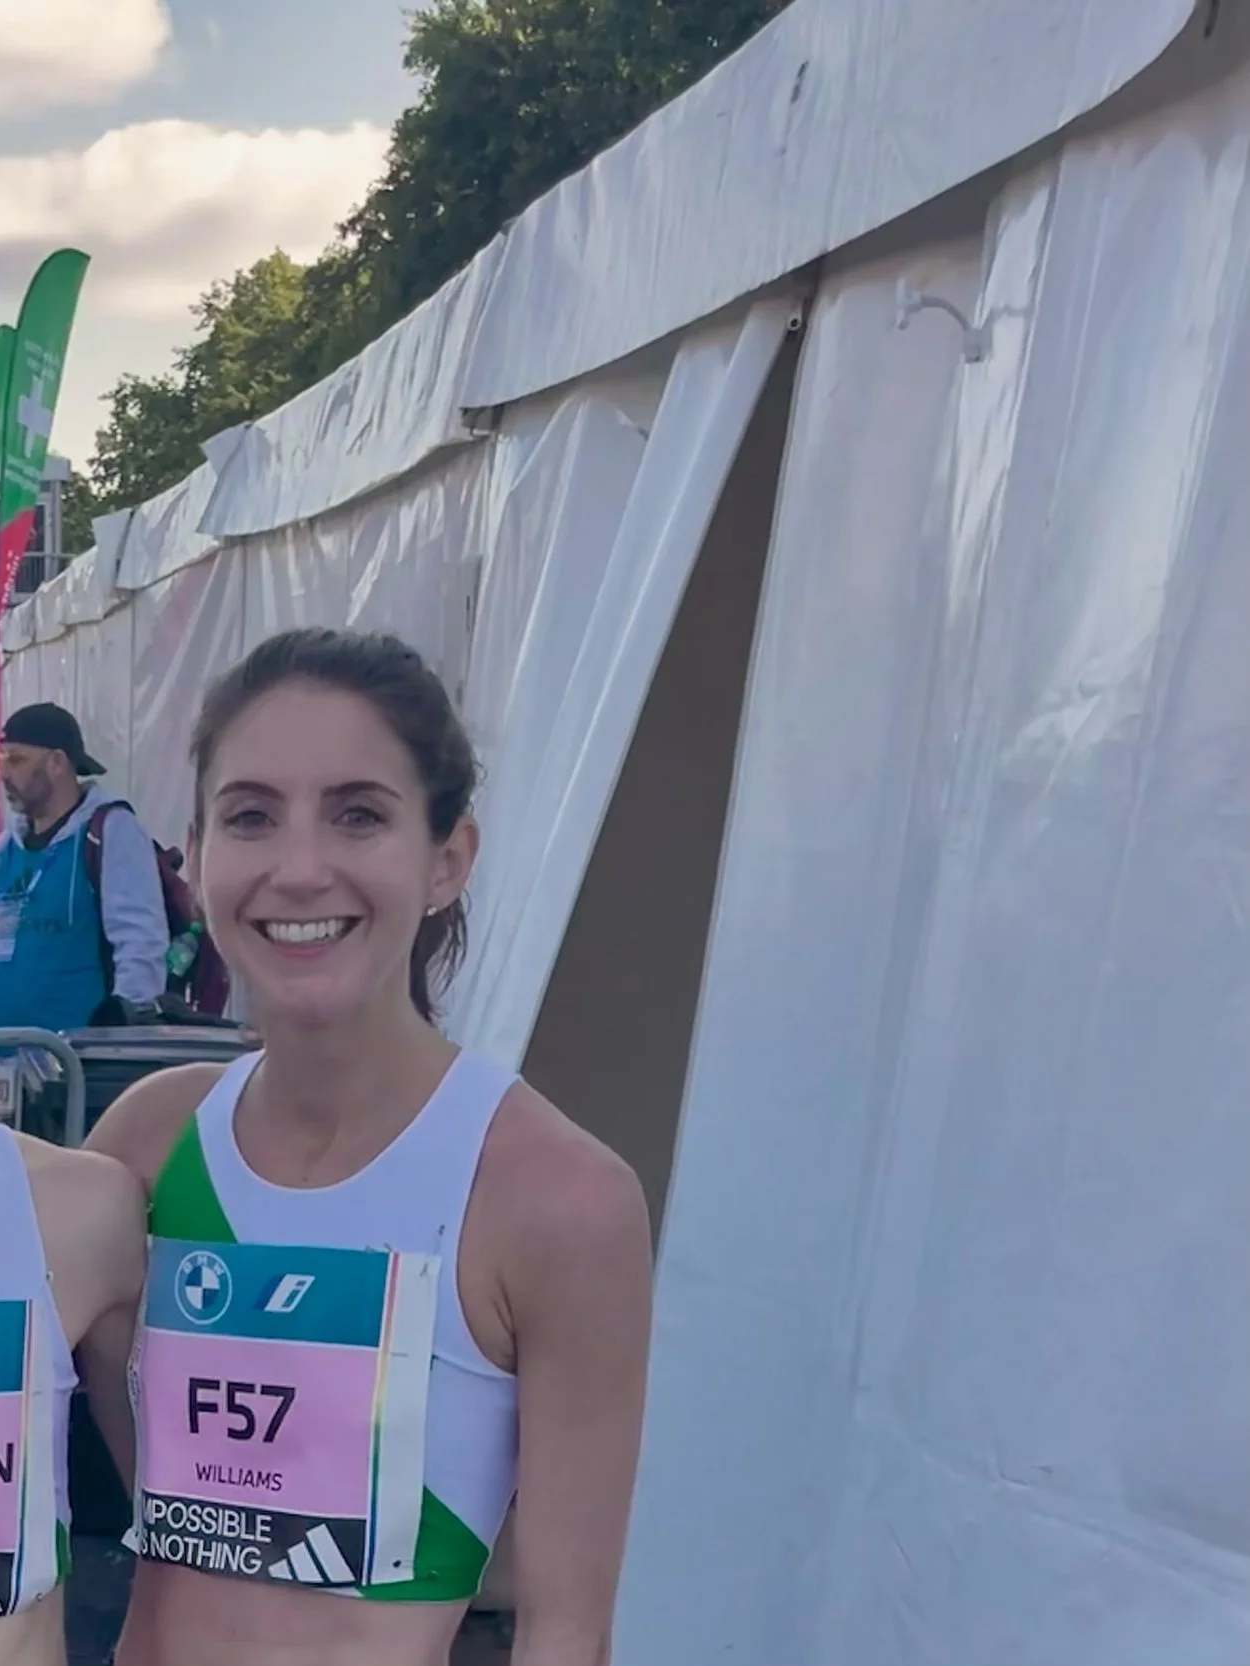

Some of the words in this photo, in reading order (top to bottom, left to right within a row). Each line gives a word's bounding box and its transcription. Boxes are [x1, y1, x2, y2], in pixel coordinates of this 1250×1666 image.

[189, 1377, 296, 1443] F57
[195, 1462, 283, 1491] WILLIAMS
[142, 1497, 272, 1543] MPOSSIBLE
[150, 1532, 263, 1574] NOTHING
